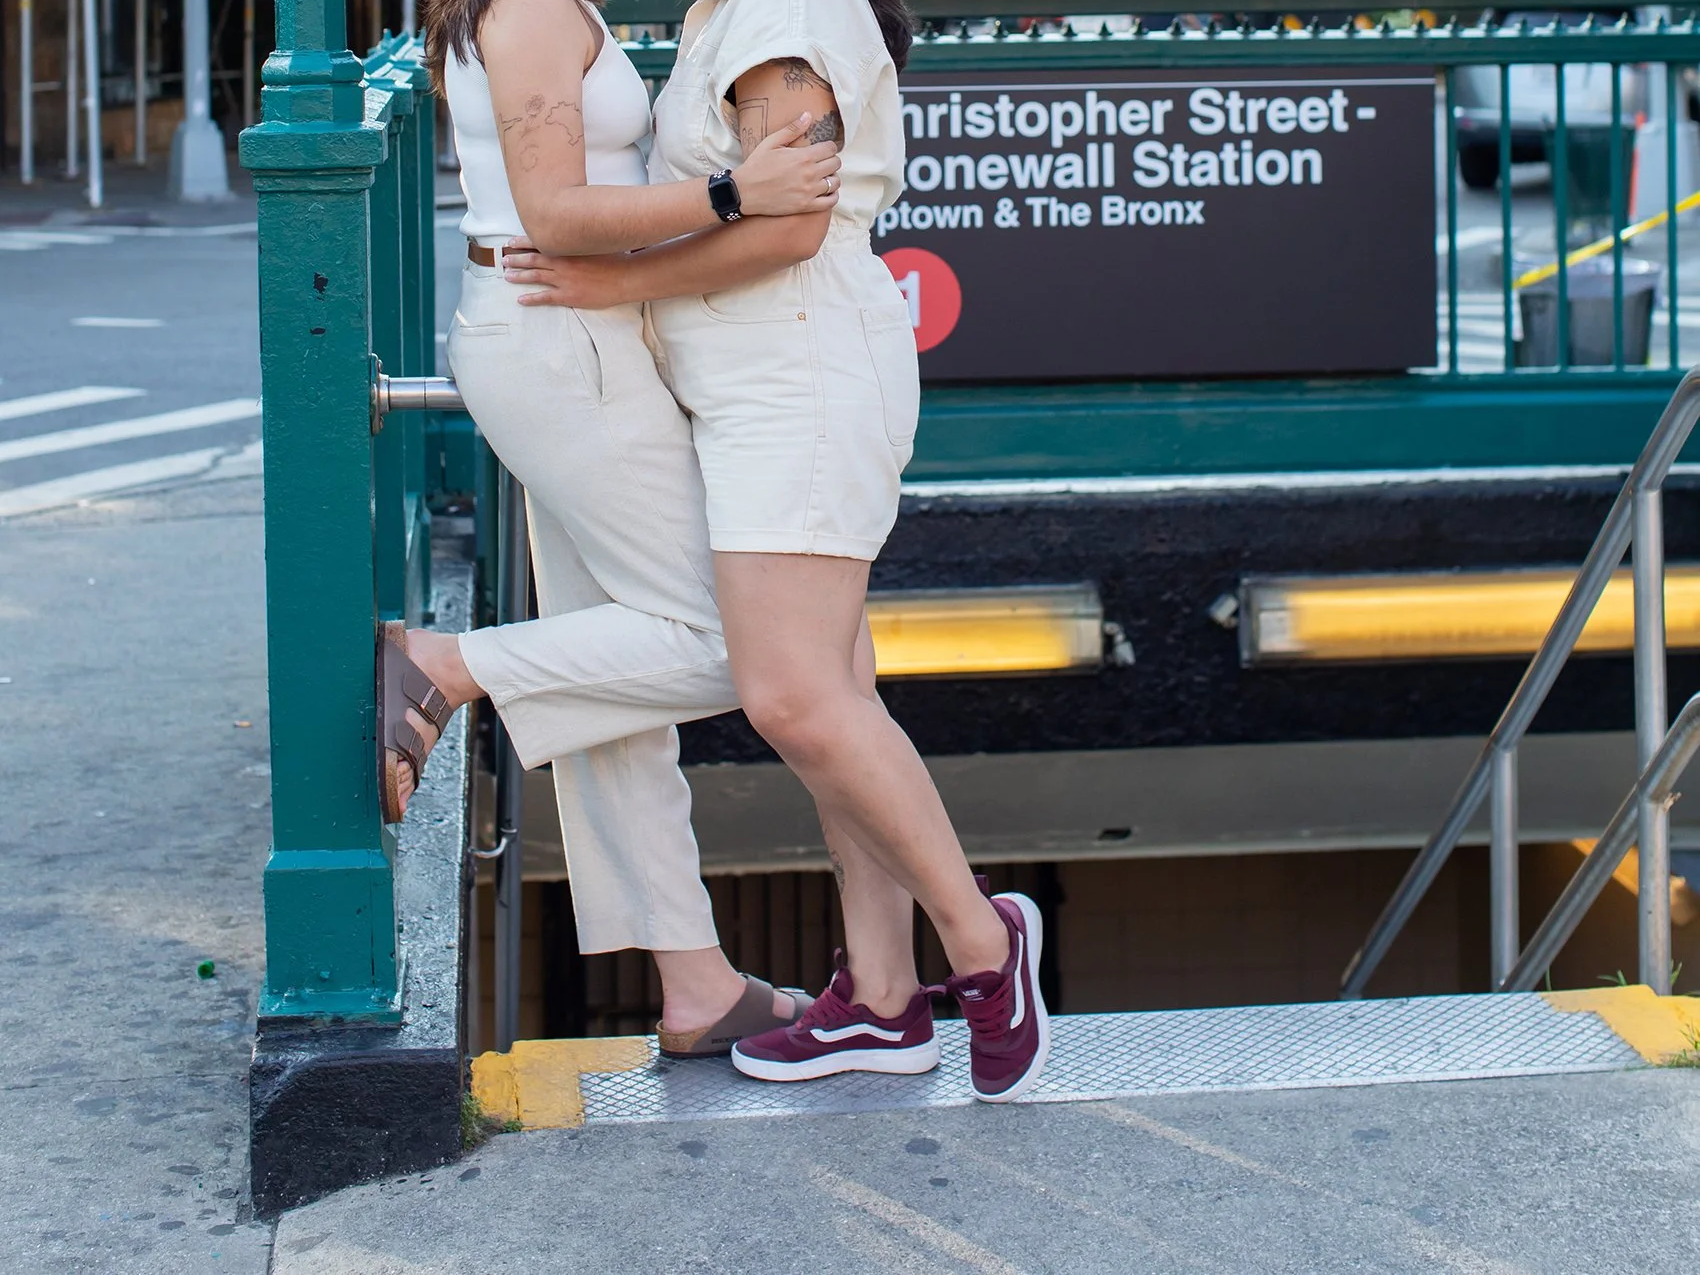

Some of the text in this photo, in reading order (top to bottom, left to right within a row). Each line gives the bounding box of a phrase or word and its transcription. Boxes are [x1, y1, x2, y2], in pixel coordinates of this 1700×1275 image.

[899, 90, 1173, 148] hristopher
[902, 140, 1323, 192] onewall Station
[874, 196, 1205, 238] ptown & The Bronx
[896, 270, 921, 328] 1
